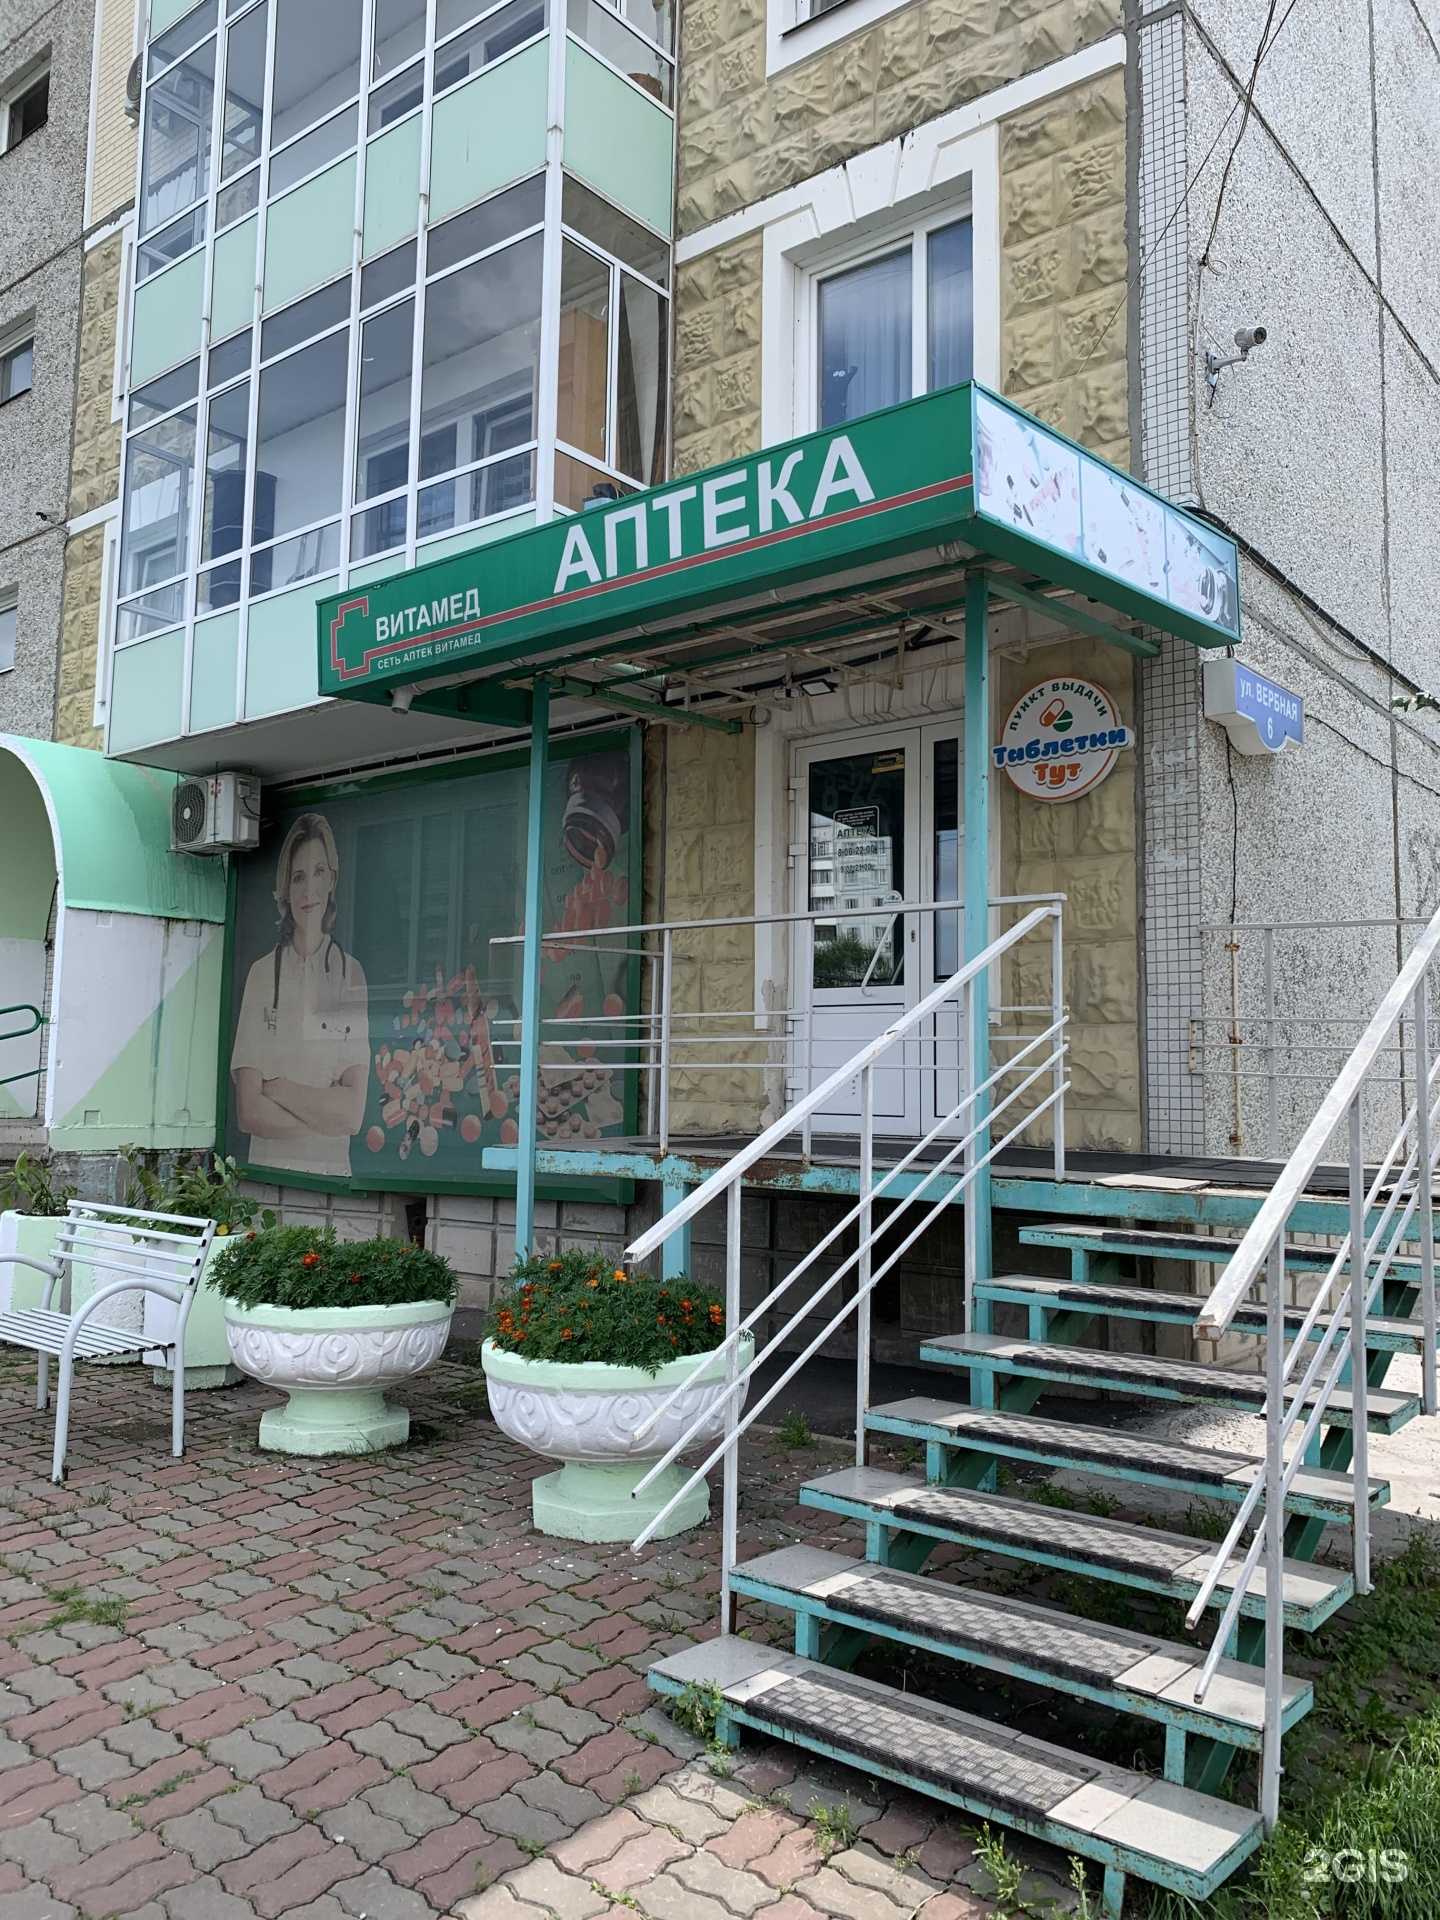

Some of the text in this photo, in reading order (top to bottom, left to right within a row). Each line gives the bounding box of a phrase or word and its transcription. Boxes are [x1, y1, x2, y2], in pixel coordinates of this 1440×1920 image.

[553, 434, 876, 595] АПТЕКА
[375, 588, 481, 642] ВИТАМЕД
[377, 632, 481, 670] СЕТЬ АПТЕК ВИТАМЕД
[1009, 682, 1108, 731] ПУНКТ ВЫДАЧИ
[1256, 682, 1298, 722] ВЕРБНАЯ
[993, 728, 1127, 765] Таблетки
[1267, 717, 1274, 740] 6
